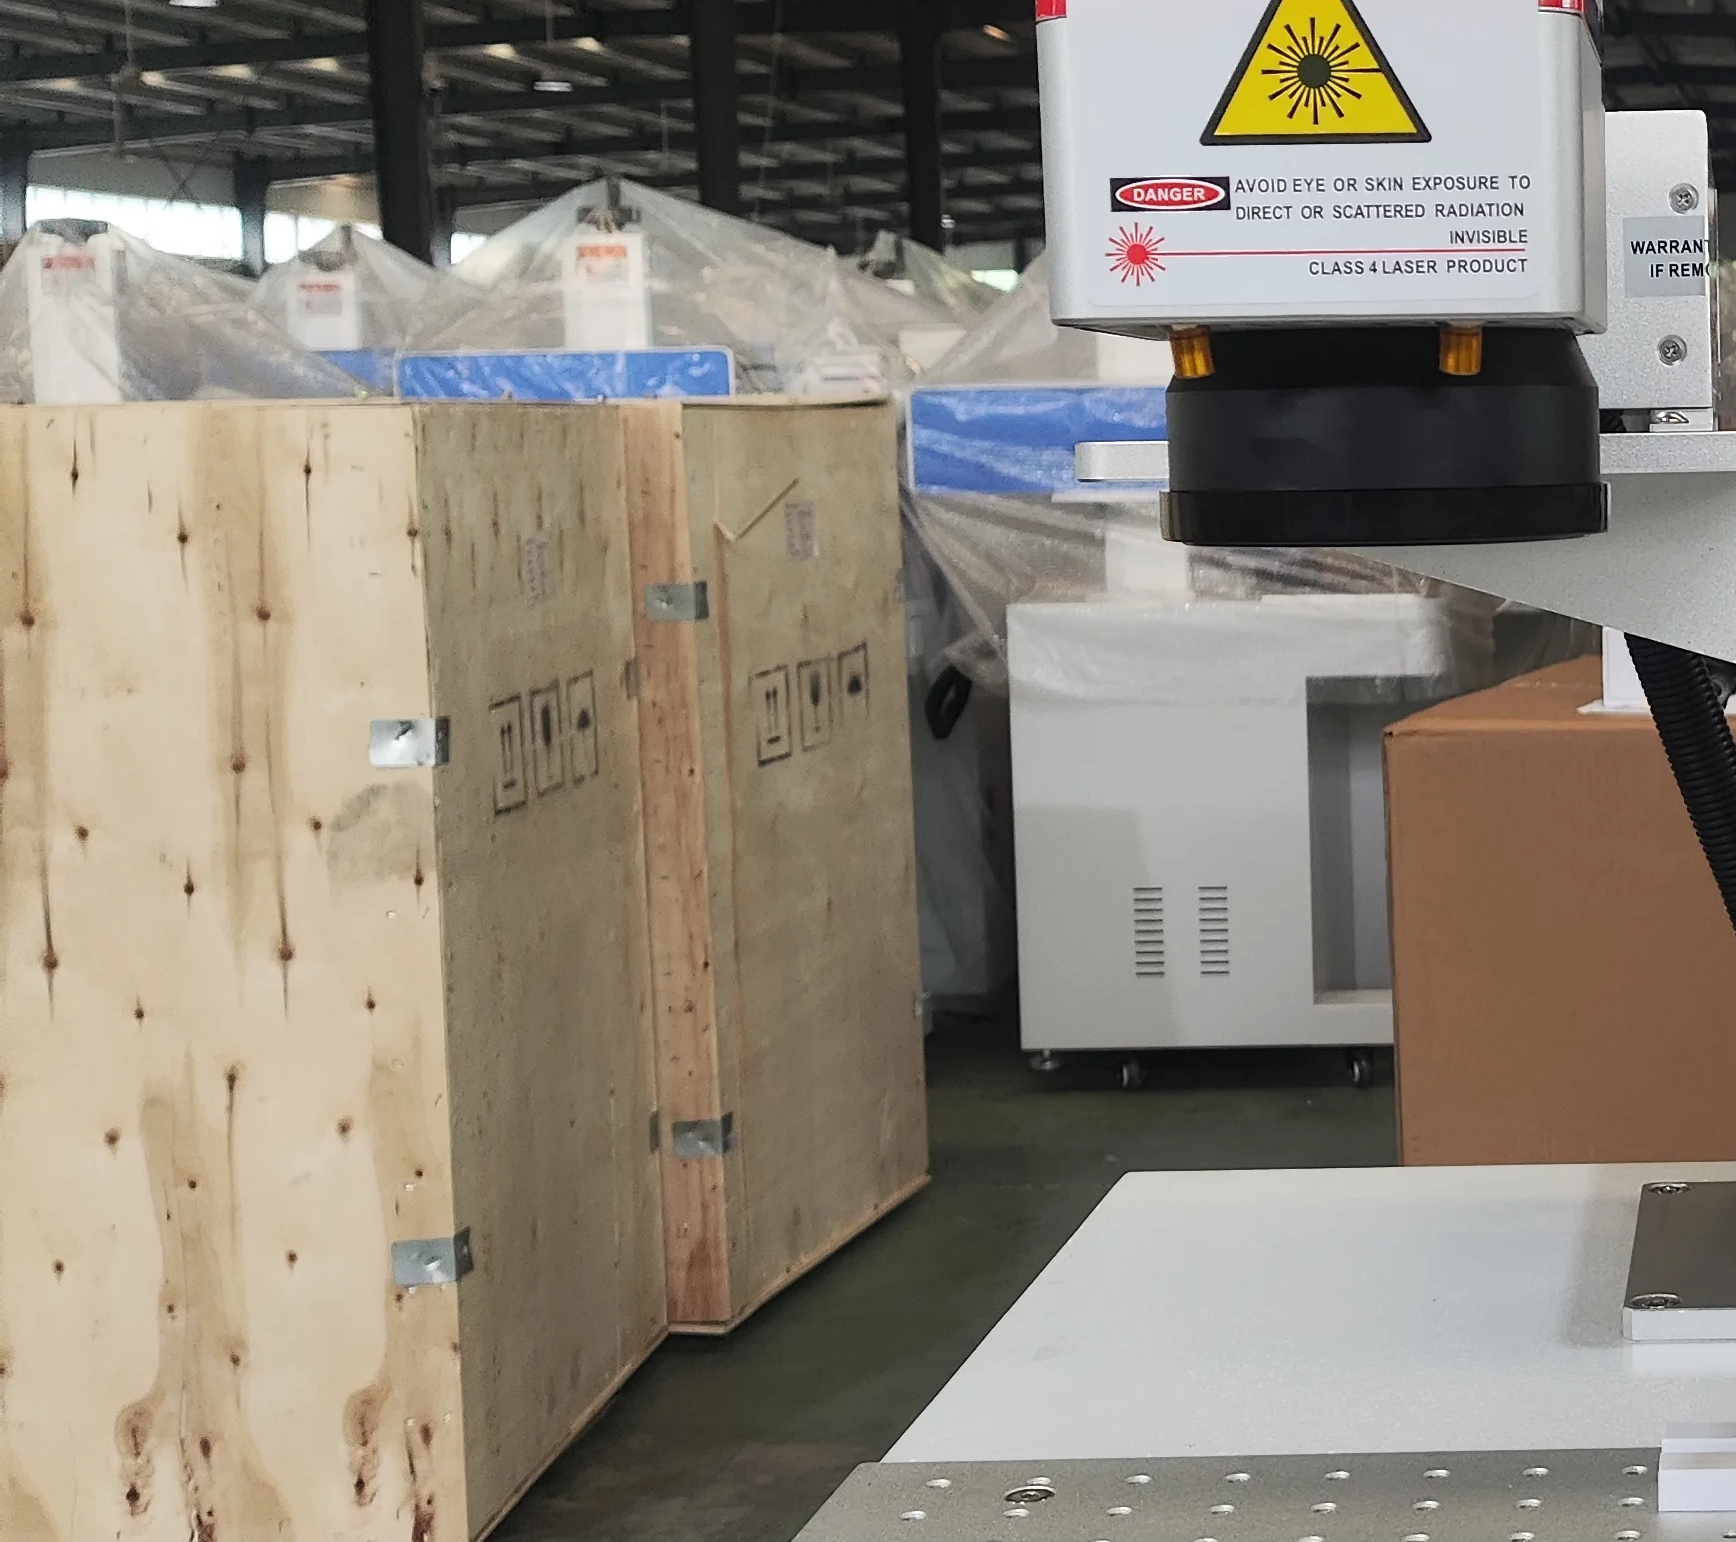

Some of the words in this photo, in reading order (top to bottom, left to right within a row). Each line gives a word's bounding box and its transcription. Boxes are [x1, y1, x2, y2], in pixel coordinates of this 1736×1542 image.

[1235, 179, 1286, 192] AVOID
[1293, 179, 1325, 192] EYE
[1334, 178, 1357, 191] OR
[1365, 177, 1403, 191] SKIN
[1412, 176, 1499, 190] EXPOSURE
[1509, 176, 1530, 189] TO
[1132, 187, 1206, 202] DANGER
[1236, 206, 1292, 220] DIRECT
[1301, 206, 1323, 219] OR
[1333, 204, 1425, 218] SCATTERED
[1436, 203, 1523, 217] RADIATION
[1450, 230, 1527, 243] INVISIBLE
[1310, 261, 1364, 275] CLASS
[1369, 261, 1377, 273] 4
[1383, 260, 1437, 274] LASER
[1447, 259, 1527, 273] PRODUCT
[1650, 263, 1664, 278] IF
